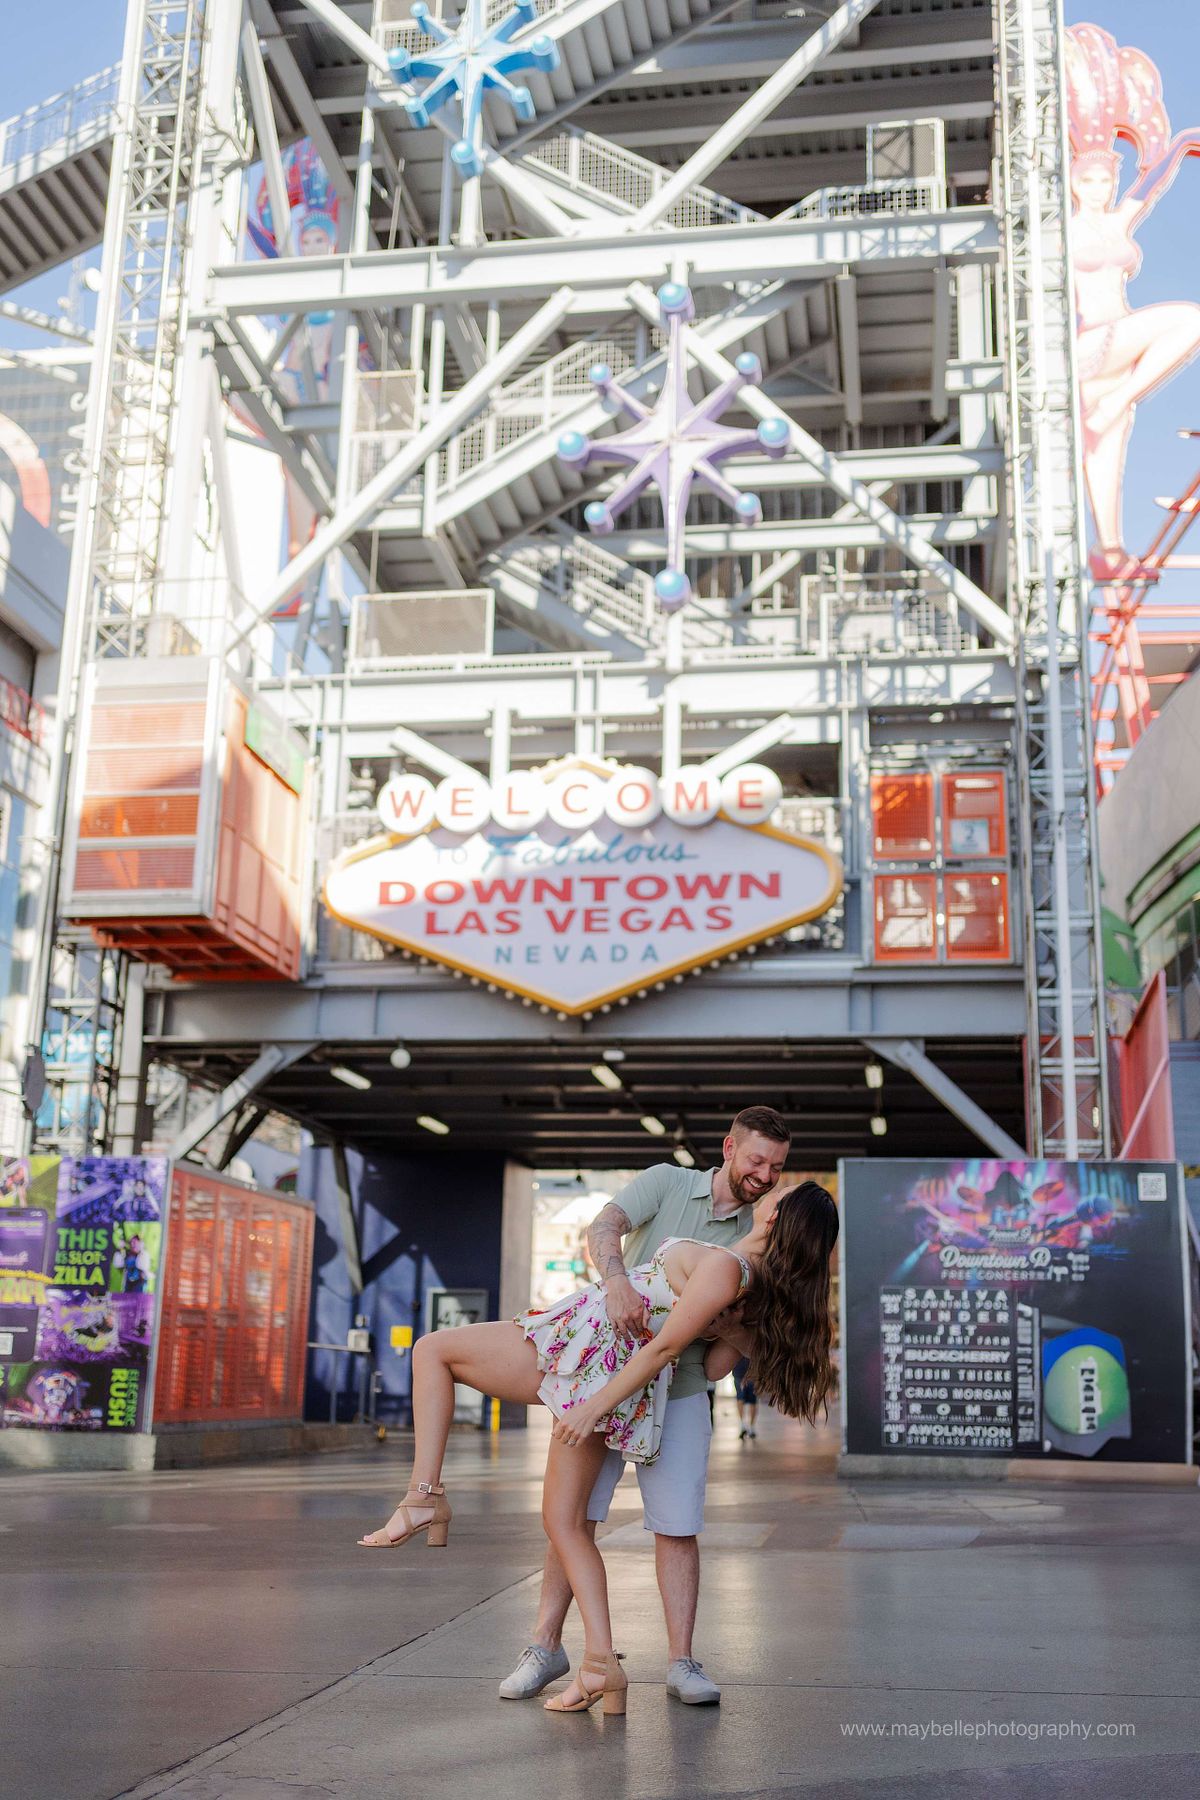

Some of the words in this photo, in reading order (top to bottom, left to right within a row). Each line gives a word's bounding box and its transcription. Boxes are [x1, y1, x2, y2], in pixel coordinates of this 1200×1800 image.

[389, 779, 764, 819] WELCOME
[482, 833, 699, 873] Fabulous
[379, 872, 782, 906] DOWNTOWN
[424, 909, 522, 935] LAS
[545, 905, 734, 936] VEGAS
[495, 944, 660, 965] NEVADA
[56, 1227, 108, 1250] THIS
[939, 1245, 1030, 1268] Downtown
[53, 1265, 105, 1286] ZILLA
[941, 1269, 973, 1281] FREE
[904, 1287, 1008, 1301] SALIVA
[904, 1310, 1010, 1323] HINDER
[936, 1323, 978, 1336] JET
[904, 1349, 1011, 1363] BUCKCHERRY
[107, 1367, 130, 1427] RUSH
[904, 1386, 949, 1400] CRAIG
[952, 1388, 1013, 1401] MORGAN
[908, 1402, 1009, 1417] ROME
[907, 1423, 1012, 1438] AWOLNATION
